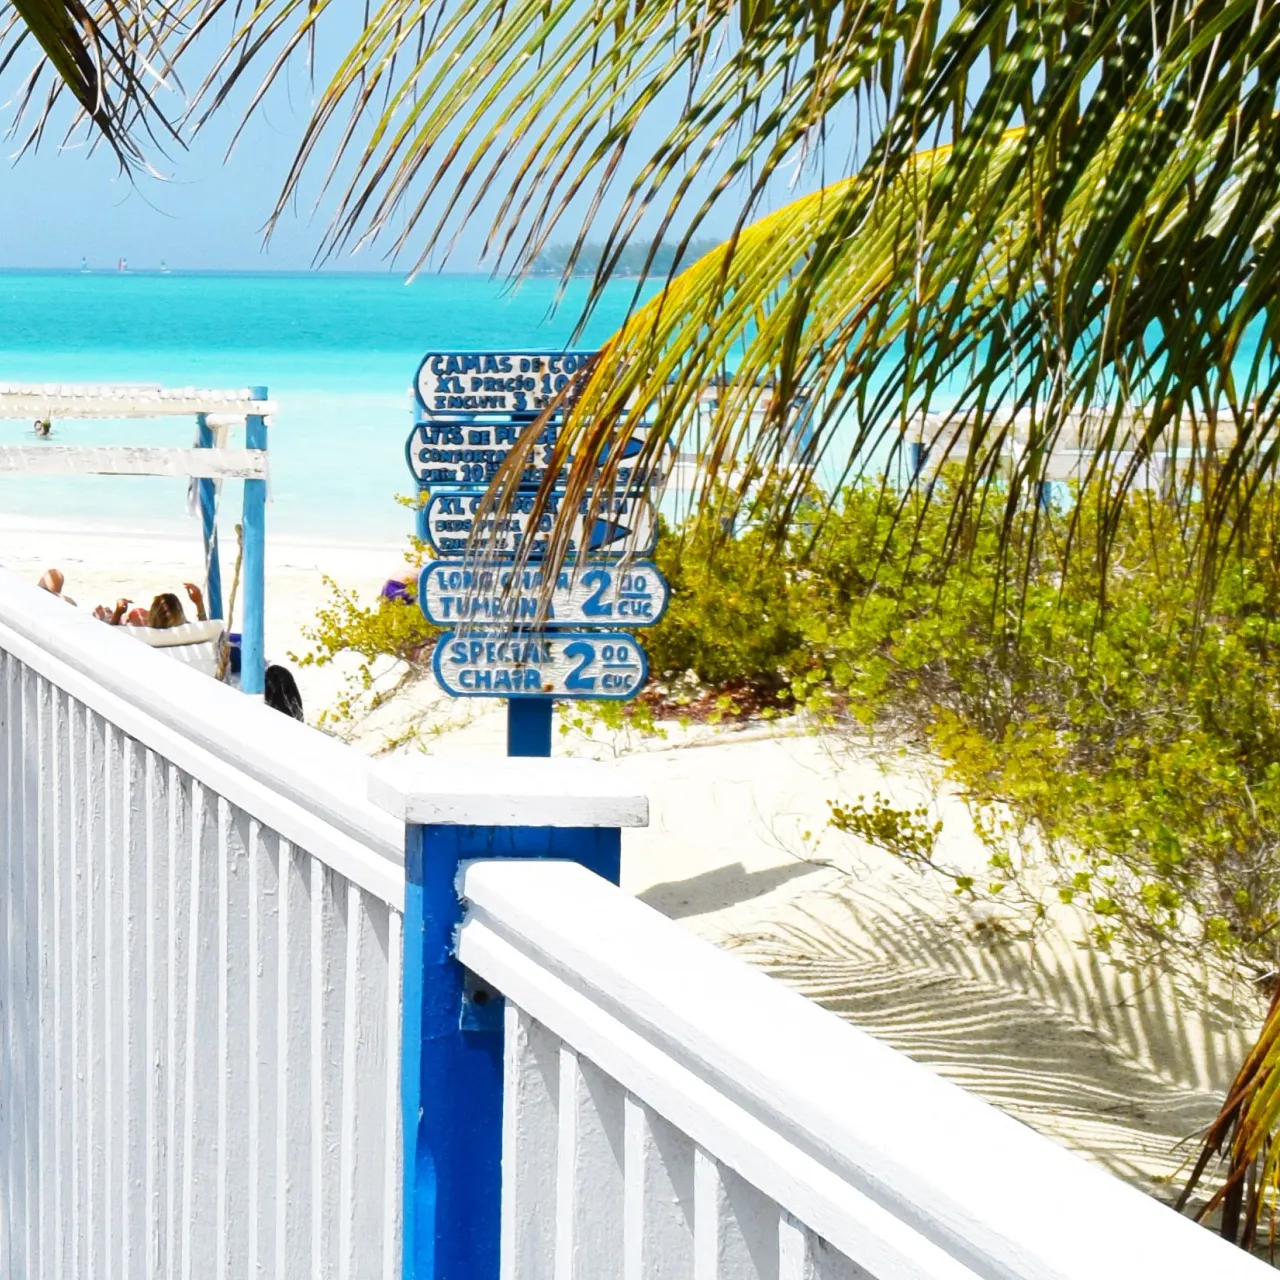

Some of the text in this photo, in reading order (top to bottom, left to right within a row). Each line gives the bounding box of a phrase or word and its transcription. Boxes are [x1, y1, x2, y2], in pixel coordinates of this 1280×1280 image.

[430, 355, 513, 376] CAMAS
[519, 357, 541, 373] DE
[434, 376, 465, 393] XL
[512, 391, 528, 411] 3
[468, 430, 490, 445] DE
[495, 426, 557, 445] PLE
[419, 448, 536, 463] CONFORTAE
[460, 464, 483, 482] 10
[438, 497, 465, 515] XL
[500, 571, 568, 590] CHAR
[580, 570, 612, 616] 2
[618, 601, 652, 617] CUC
[563, 641, 628, 690] 2 00
[602, 673, 632, 688] CUC
